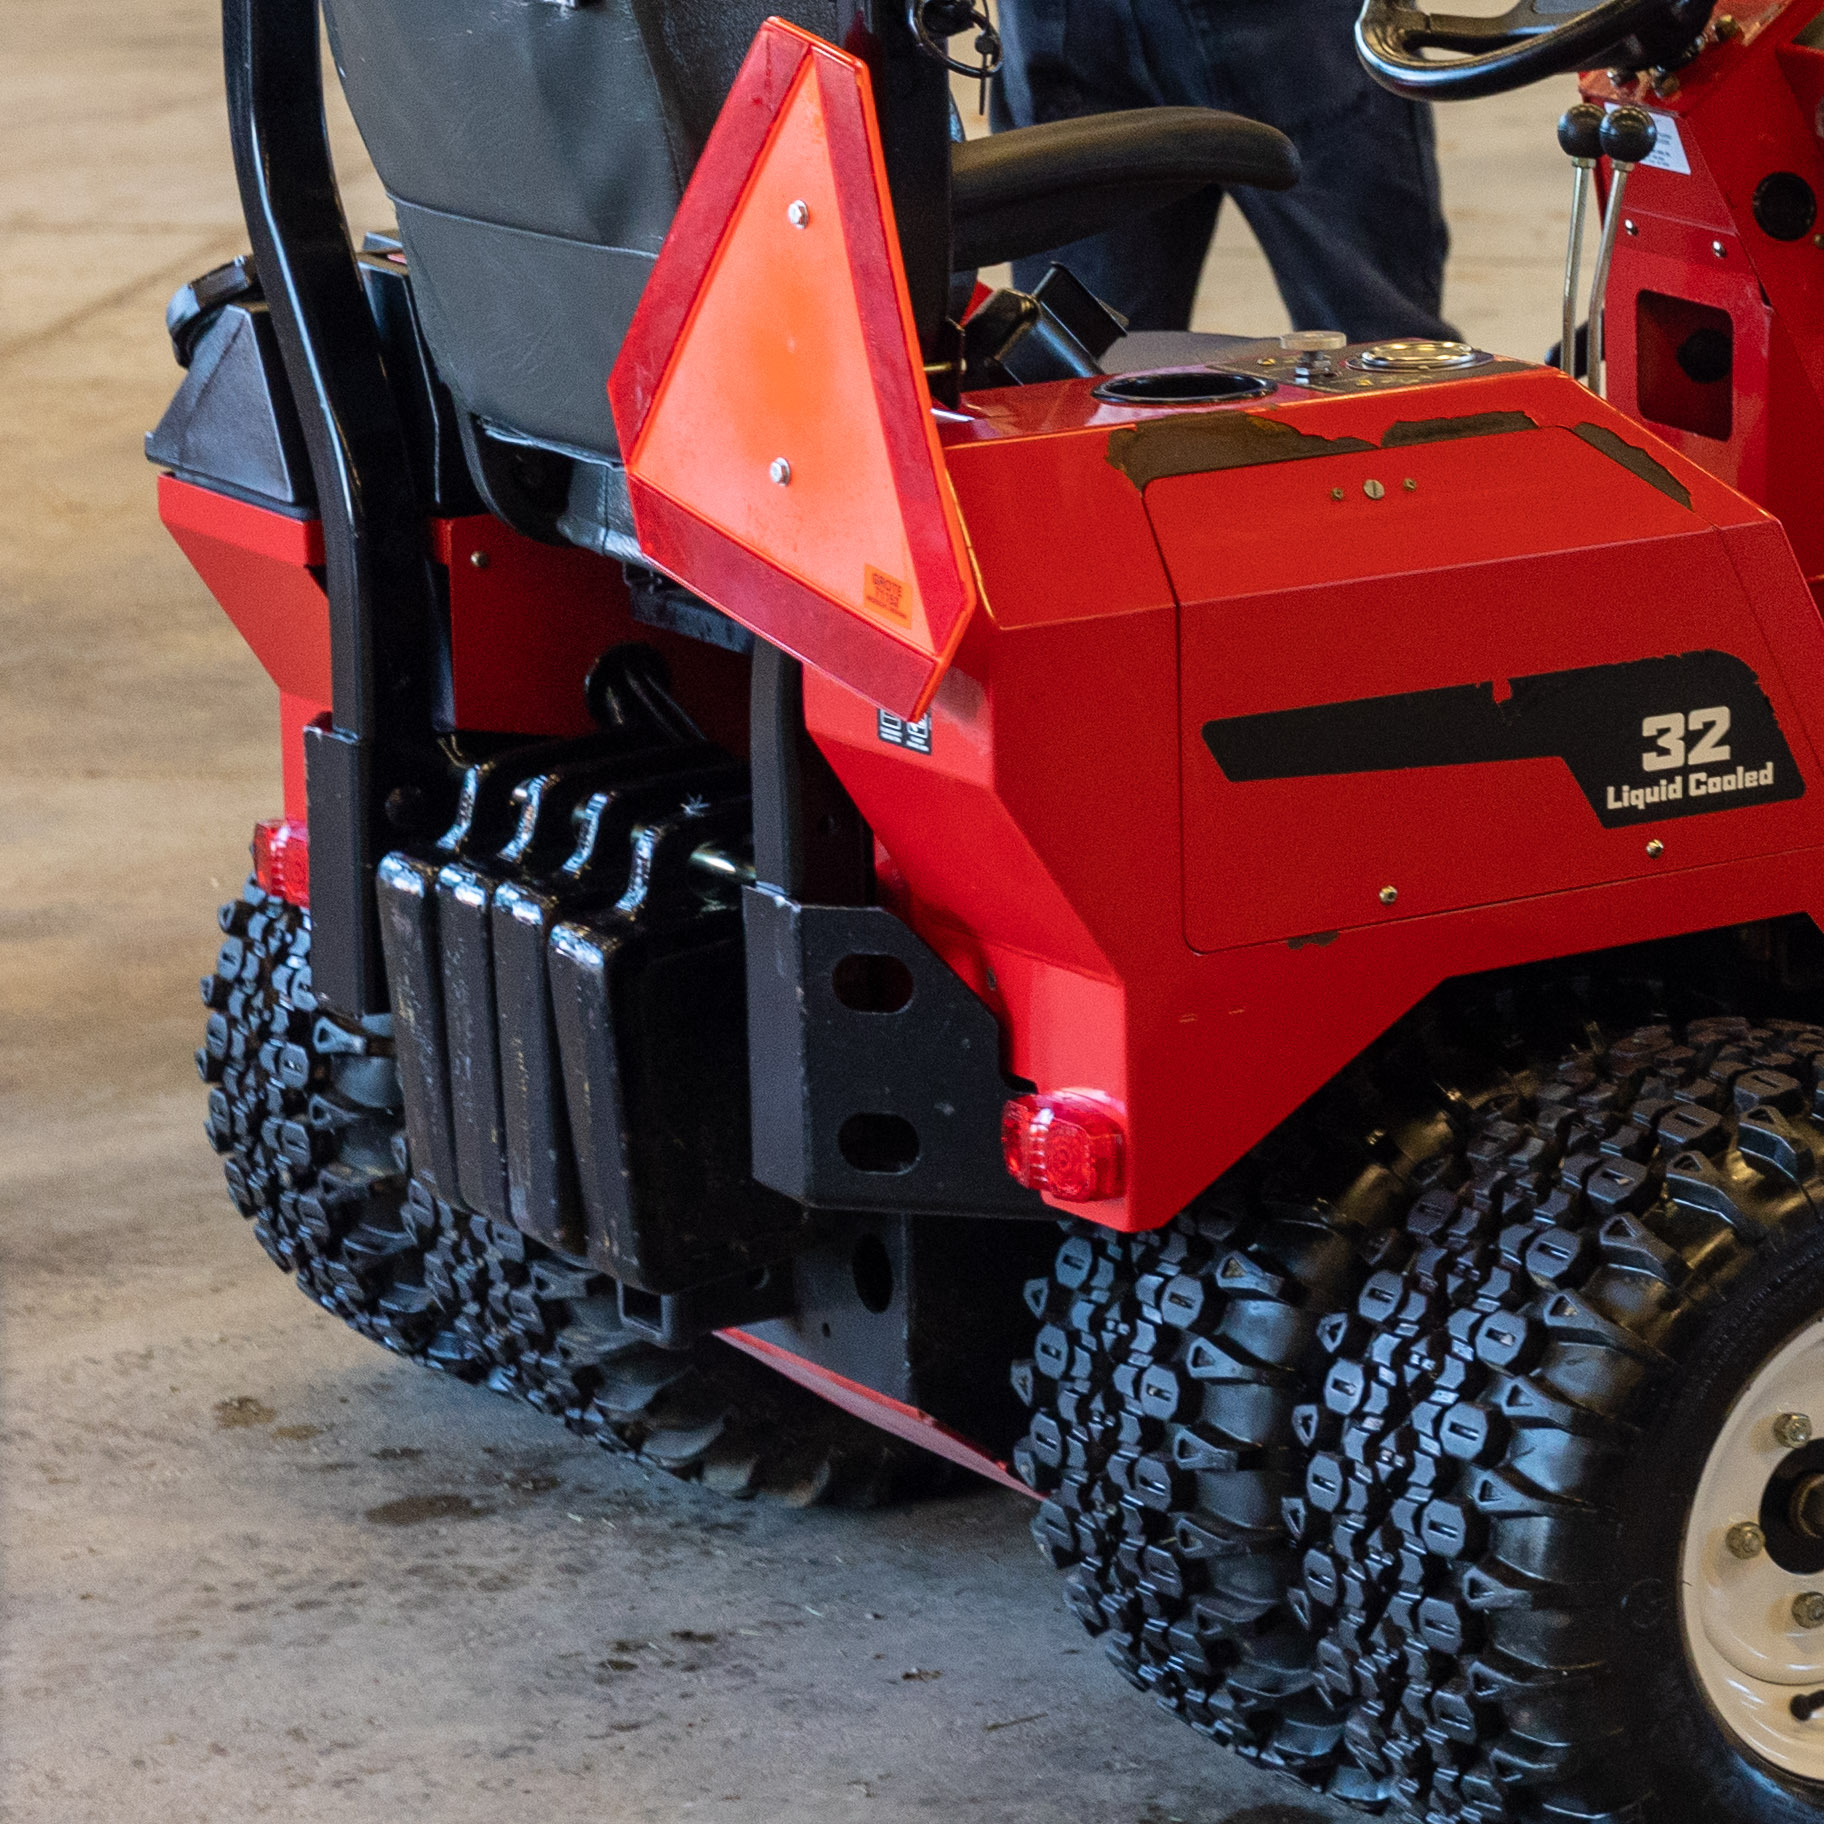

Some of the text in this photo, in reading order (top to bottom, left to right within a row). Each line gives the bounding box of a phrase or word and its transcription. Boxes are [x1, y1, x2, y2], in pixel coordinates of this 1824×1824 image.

[1642, 706, 1731, 772] 32
[1606, 761, 1774, 810] Liquid Cooled
